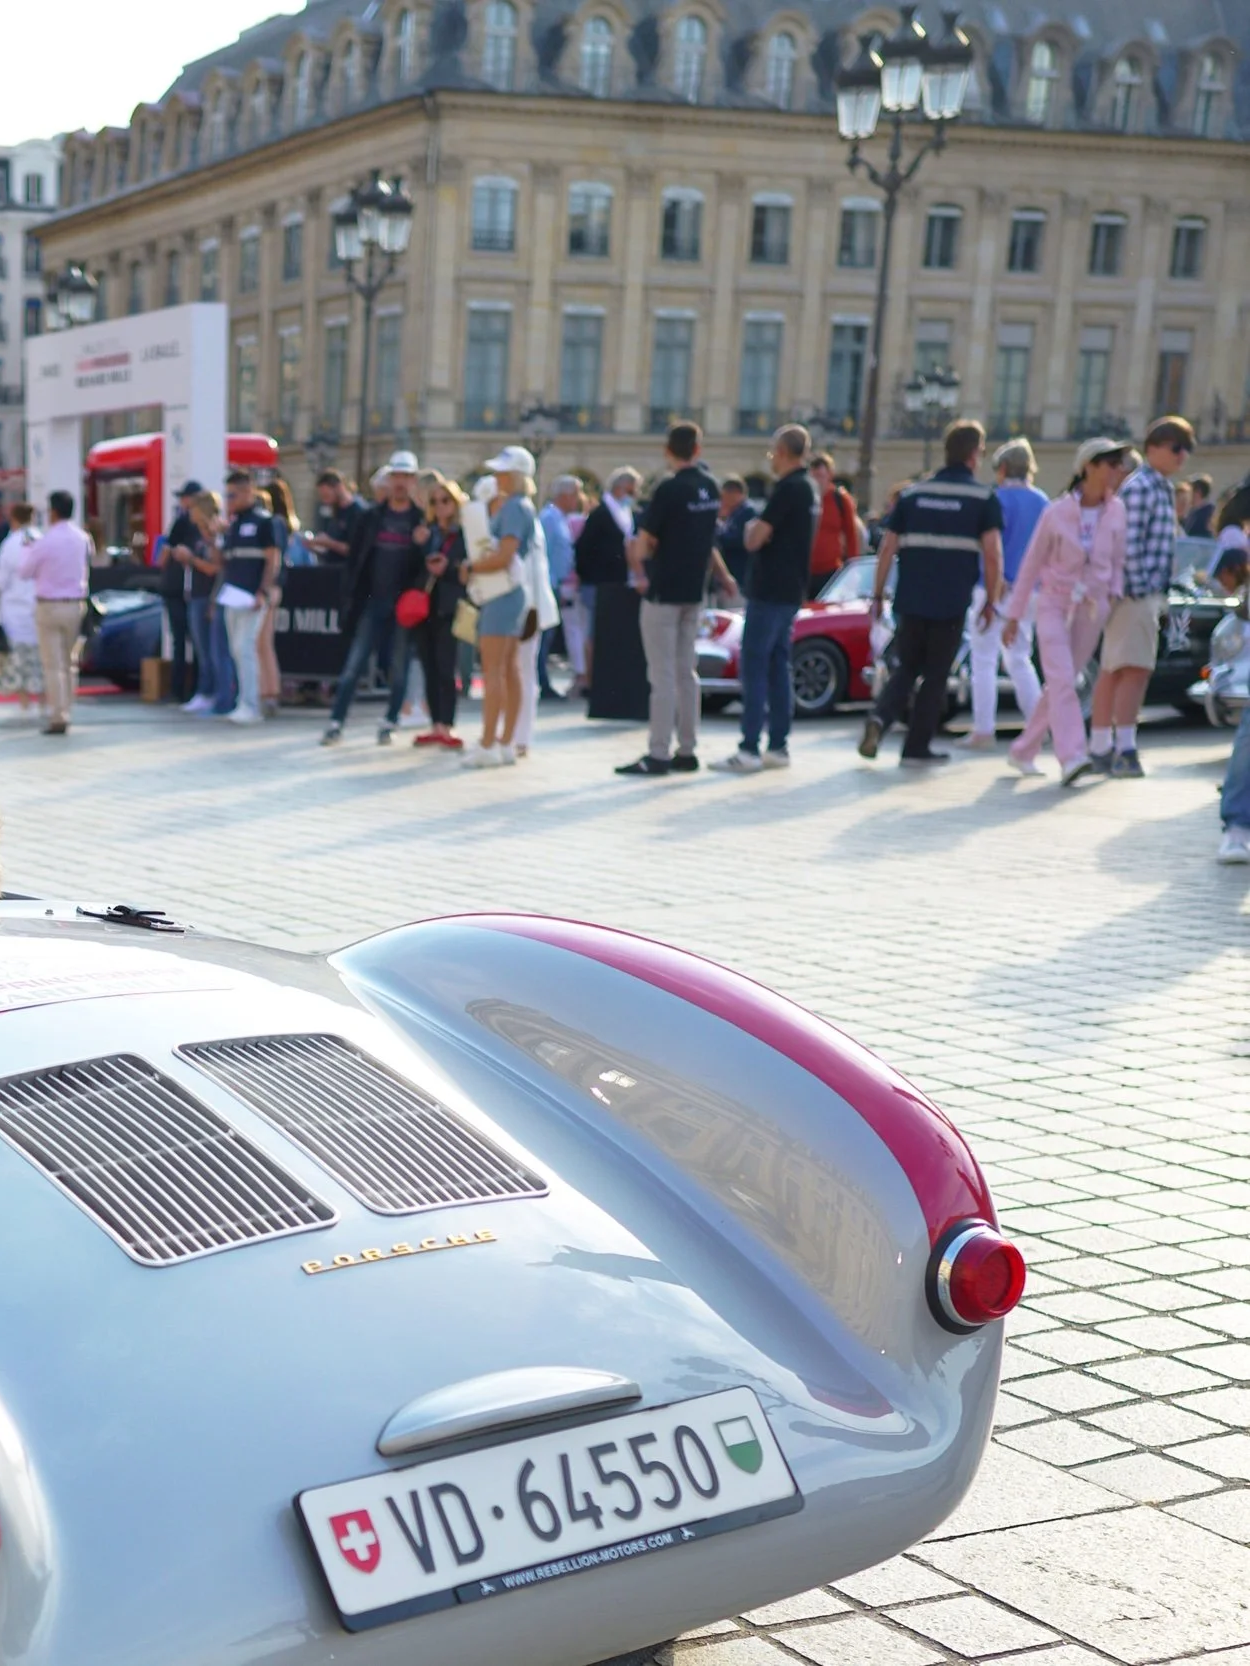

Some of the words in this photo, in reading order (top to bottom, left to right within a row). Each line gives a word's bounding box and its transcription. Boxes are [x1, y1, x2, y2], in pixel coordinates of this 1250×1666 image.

[293, 607, 342, 634] MILL
[301, 1228, 497, 1276] PORSCHE
[501, 1532, 674, 1590] WWW.REBELLION-MOTORS.COM
